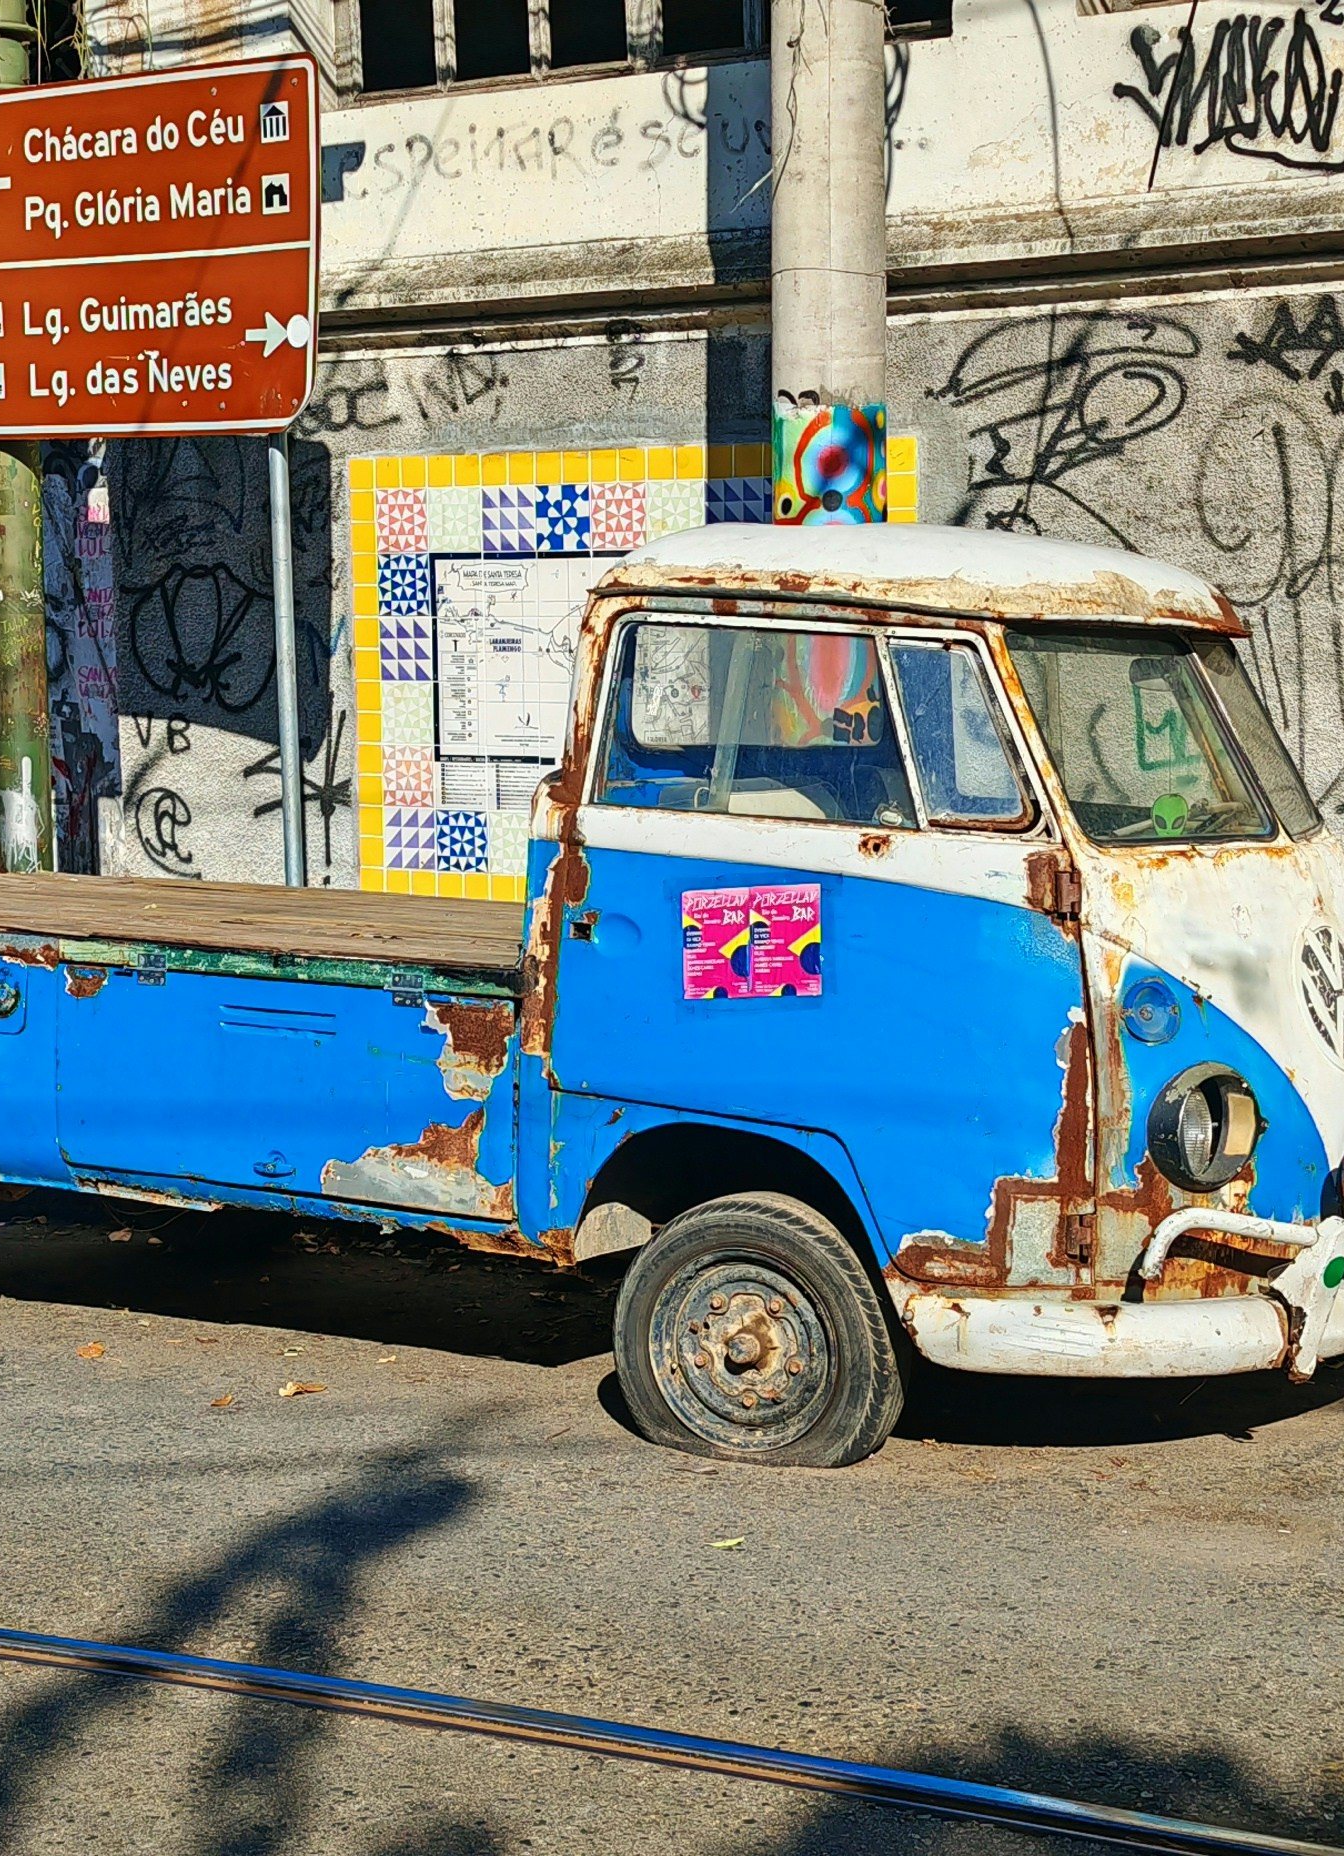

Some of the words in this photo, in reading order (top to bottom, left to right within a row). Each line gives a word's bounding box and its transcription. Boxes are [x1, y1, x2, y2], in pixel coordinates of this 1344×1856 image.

[24, 126, 138, 164] Chácara
[146, 115, 180, 152] do
[187, 109, 245, 148] Céu
[25, 195, 69, 240] Pq.
[74, 186, 160, 228] Glória
[169, 177, 252, 220] Maria
[23, 301, 70, 345] Lg.
[80, 291, 233, 333] Guimarães
[29, 363, 76, 408] Lg.
[86, 360, 140, 395] das
[148, 357, 233, 394] Neves
[721, 908, 746, 926] BAR
[790, 905, 816, 923] BAR
